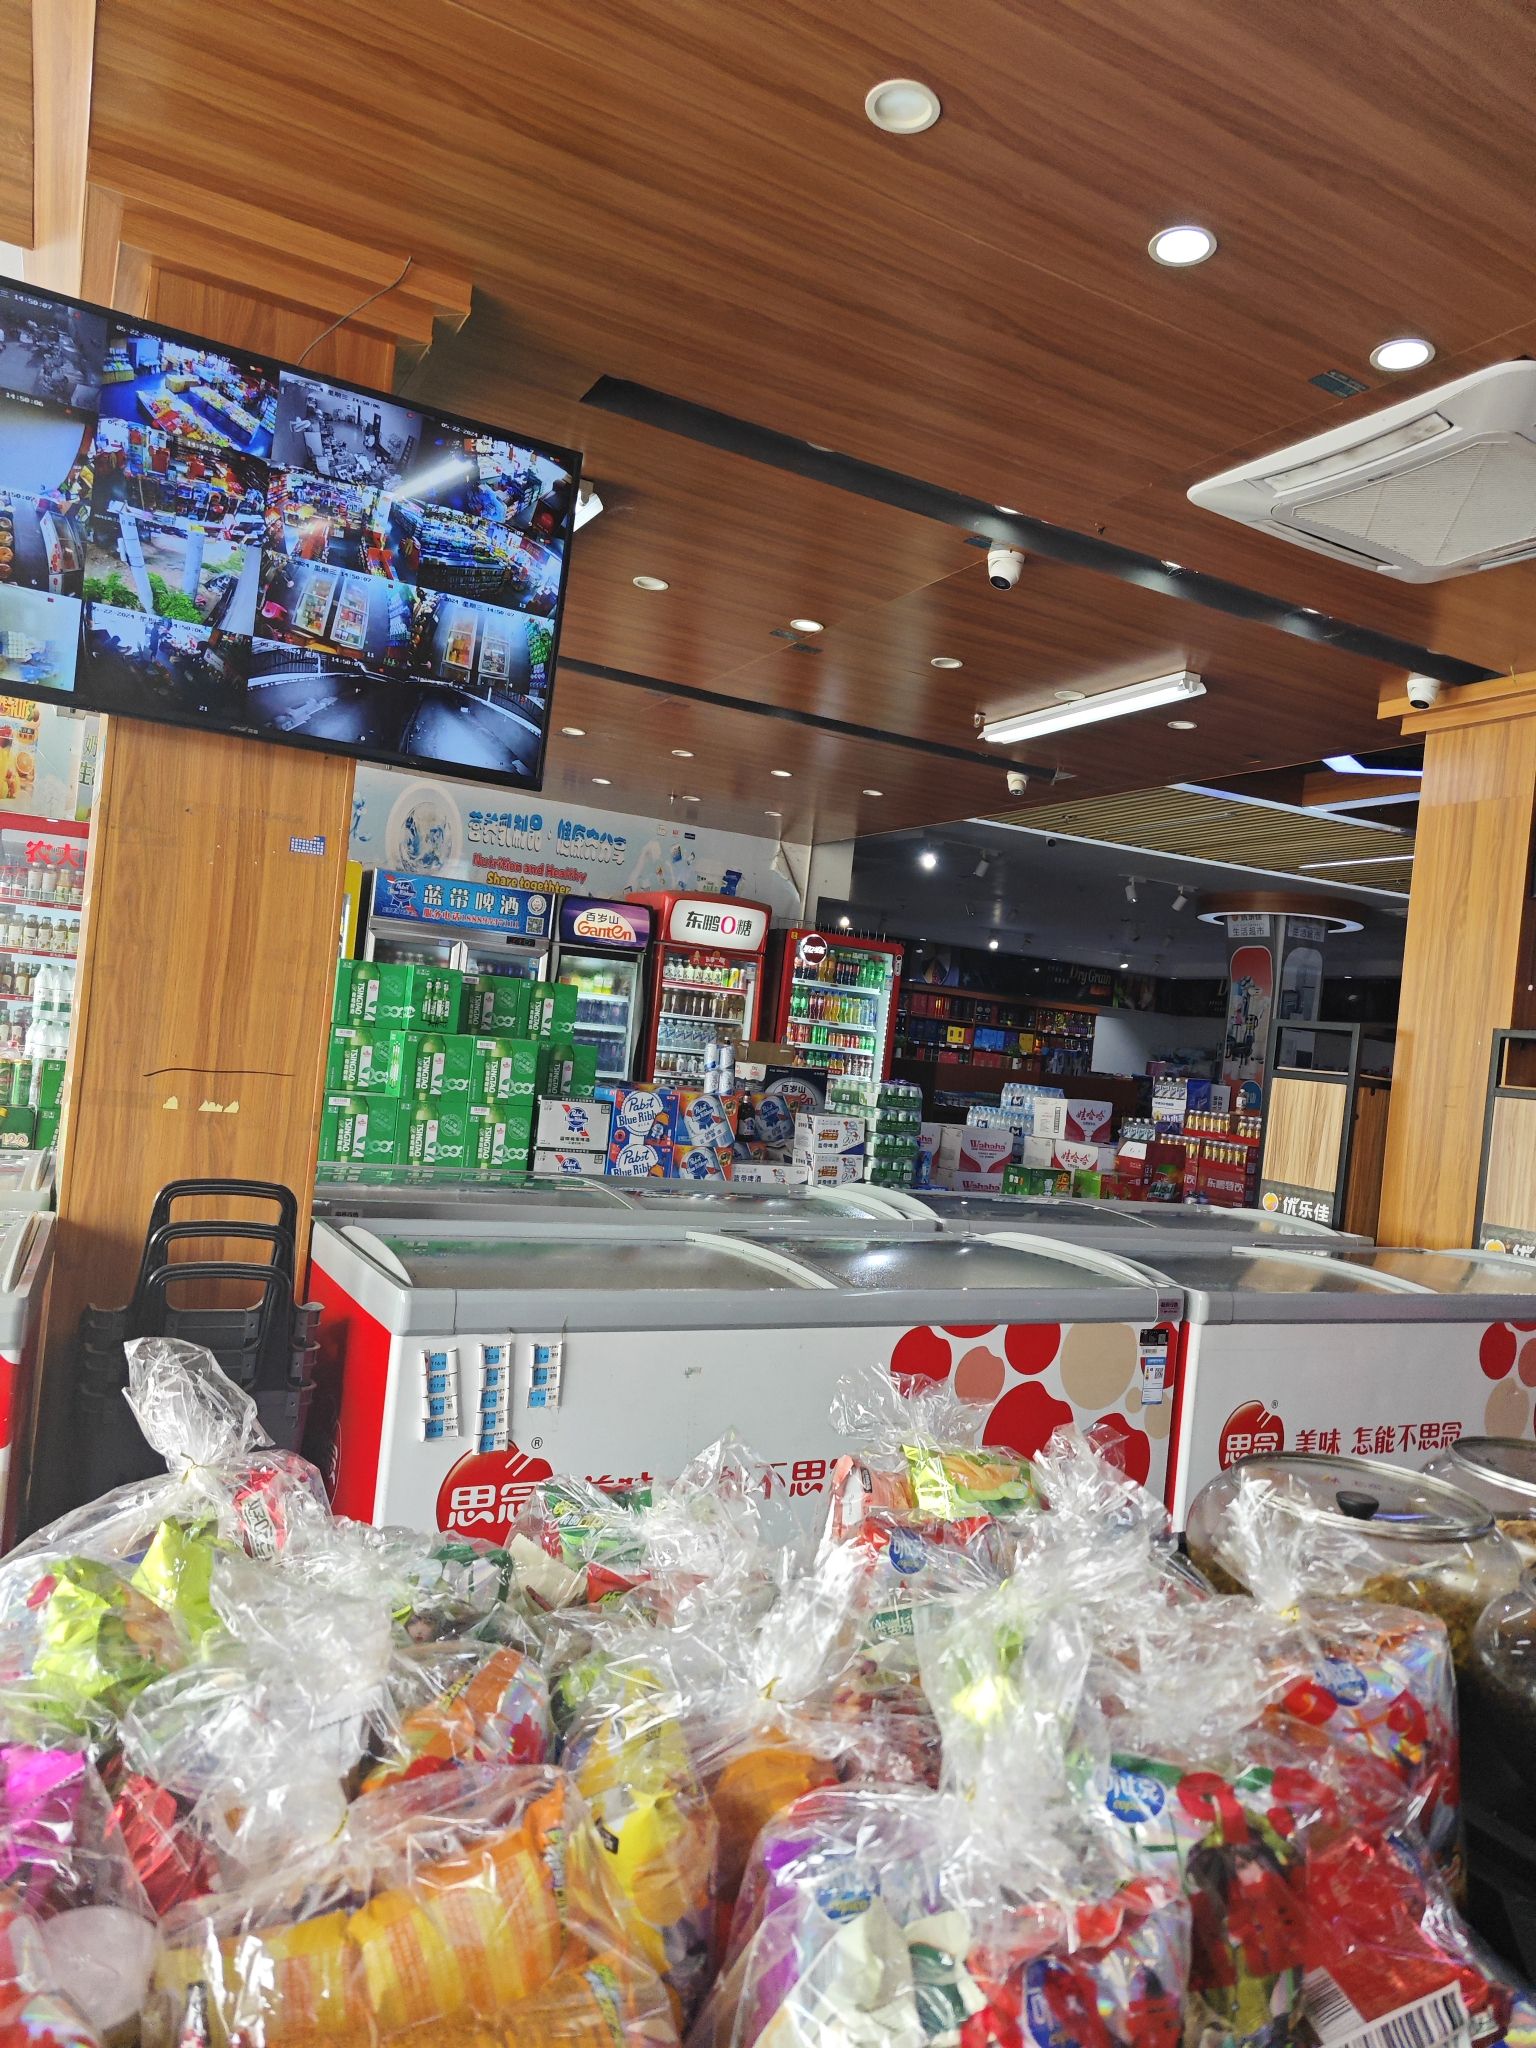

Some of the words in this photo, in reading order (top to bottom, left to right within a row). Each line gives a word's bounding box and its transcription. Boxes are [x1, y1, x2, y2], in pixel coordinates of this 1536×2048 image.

[472, 852, 523, 875] Nutrition
[523, 863, 542, 876] and
[545, 864, 588, 884] Healthy
[487, 871, 518, 888] Share
[423, 884, 520, 917] 蓝带啤酒
[586, 912, 619, 925] 百岁山
[488, 1060, 499, 1093] TSINGTAO
[629, 1097, 655, 1112] Pabst
[618, 1115, 638, 1127] Blue
[342, 1117, 353, 1152] TSINGTAO
[414, 1123, 425, 1157] TSINGTAO
[482, 1127, 492, 1160] TSINGTAO
[970, 1139, 1006, 1150] Wahaha
[623, 1150, 649, 1165] Pabst
[1061, 1149, 1089, 1166] 娃哈哈
[963, 1181, 1000, 1191] Wahaha
[1283, 1196, 1330, 1223] 优乐佳
[1295, 1428, 1341, 1455] 美味
[1351, 1421, 1463, 1456] 怎能不思念
